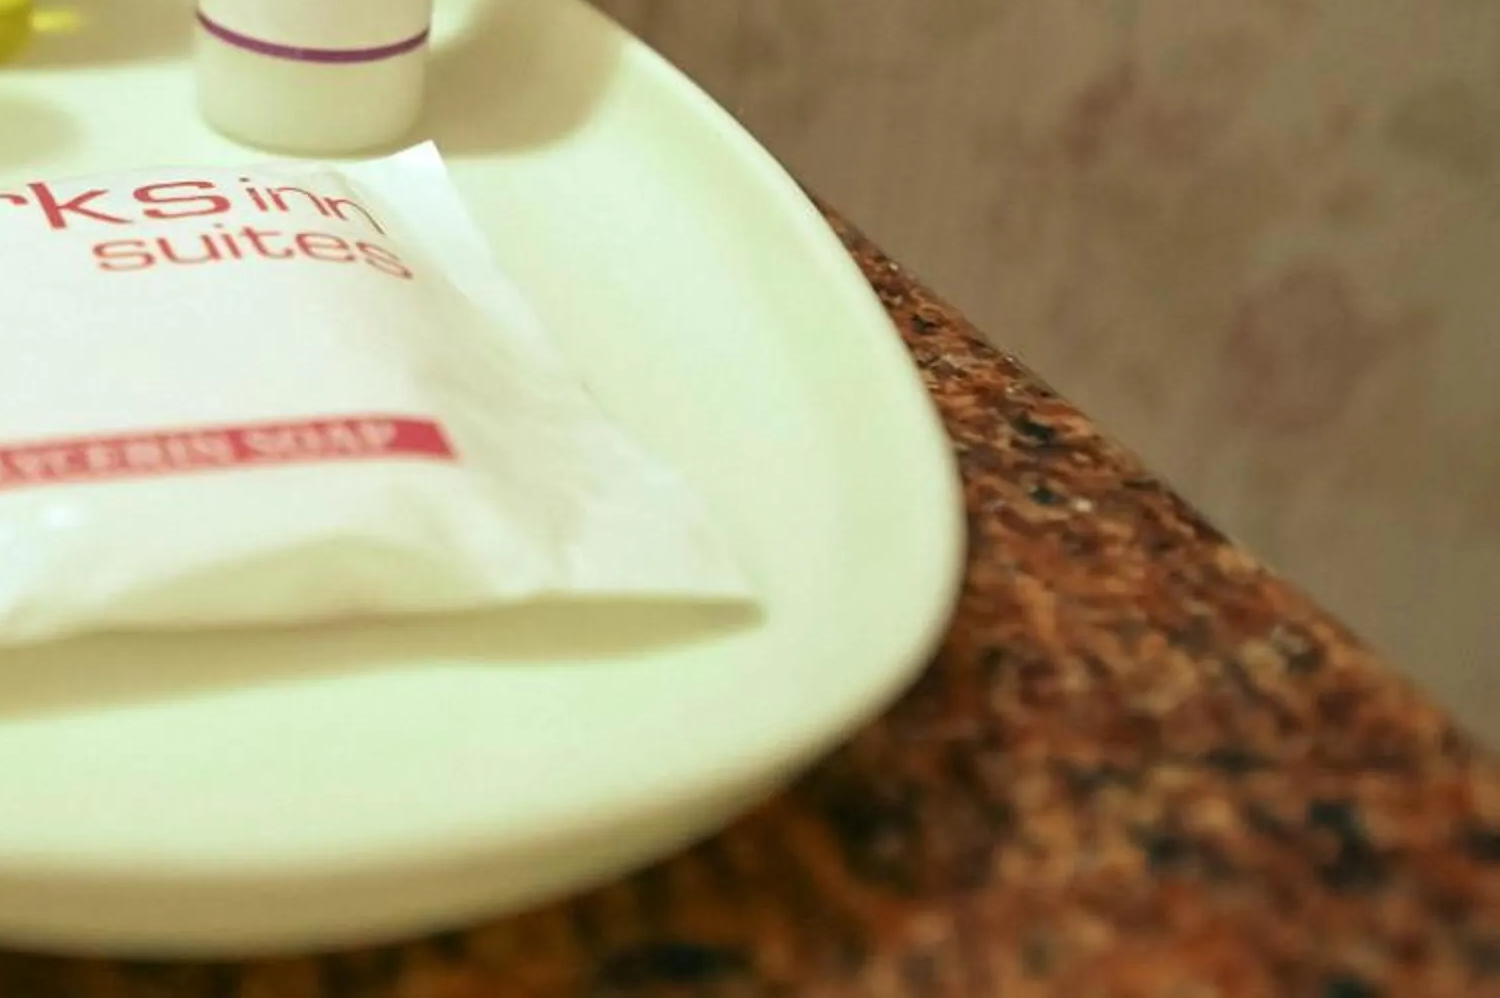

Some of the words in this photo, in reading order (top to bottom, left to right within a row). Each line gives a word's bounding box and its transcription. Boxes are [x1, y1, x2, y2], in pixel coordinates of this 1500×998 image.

[243, 175, 387, 235] inn
[92, 222, 415, 281] suites
[244, 417, 399, 462] SOAP
